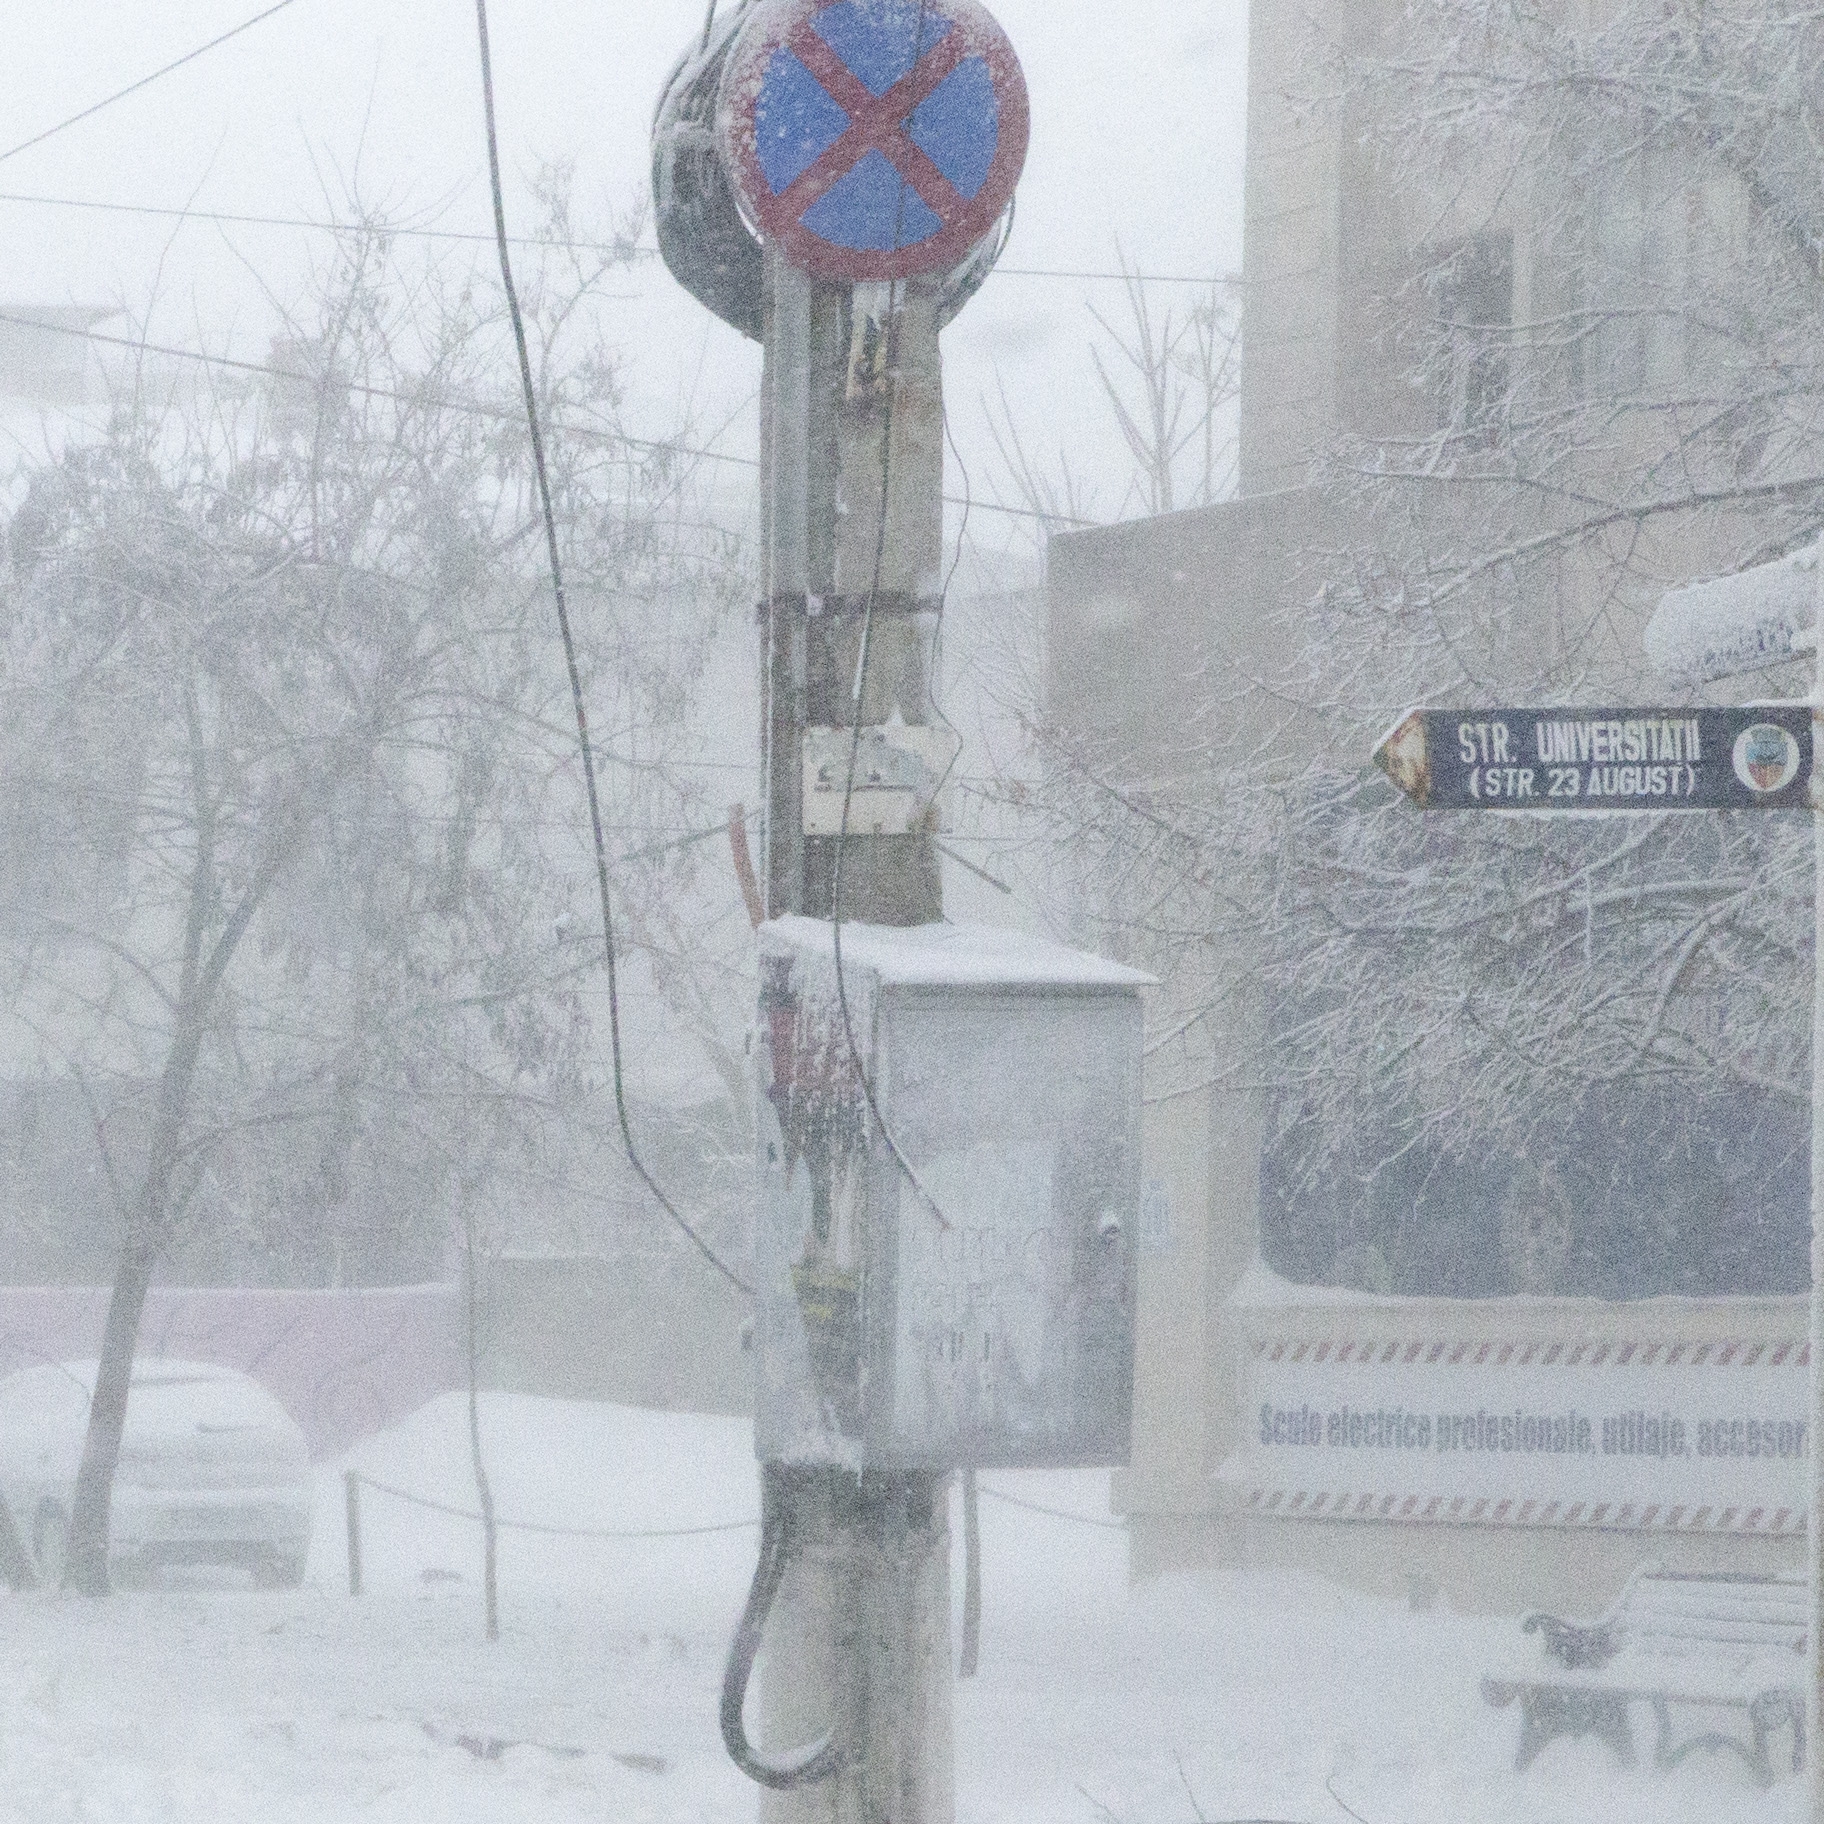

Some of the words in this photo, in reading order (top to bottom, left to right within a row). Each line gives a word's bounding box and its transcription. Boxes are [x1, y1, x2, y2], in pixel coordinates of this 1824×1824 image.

[1458, 722, 1517, 763] STR.
[1468, 766, 1540, 798] (STR.
[1547, 767, 1581, 797] 23
[1586, 764, 1695, 797] AUGUST)
[1259, 1402, 1322, 1446] Scule
[1327, 1404, 1431, 1450] electrice
